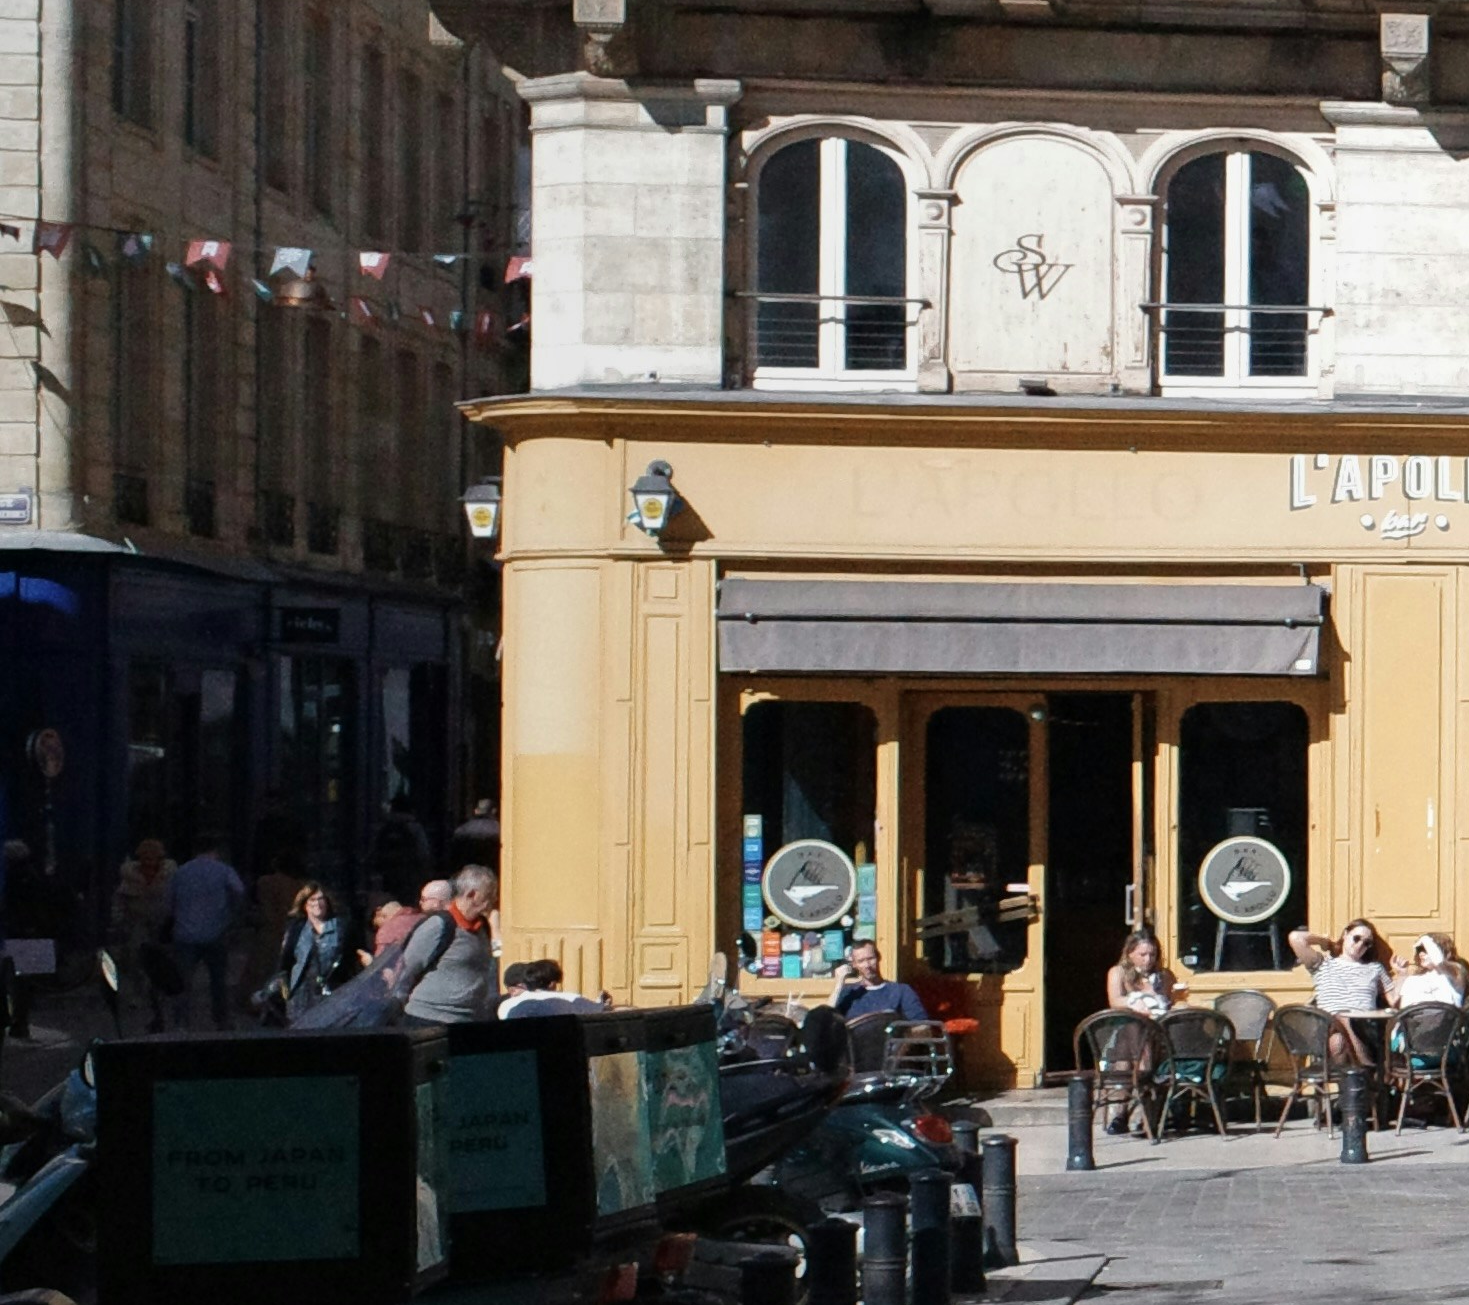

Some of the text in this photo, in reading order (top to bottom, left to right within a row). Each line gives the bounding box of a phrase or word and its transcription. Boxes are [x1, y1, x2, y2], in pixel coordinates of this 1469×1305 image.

[1380, 509, 1429, 539] bar
[458, 1112, 530, 1131] JAPAN
[167, 1145, 346, 1166] FROM JAPAN
[195, 1174, 317, 1193] TO PERU
